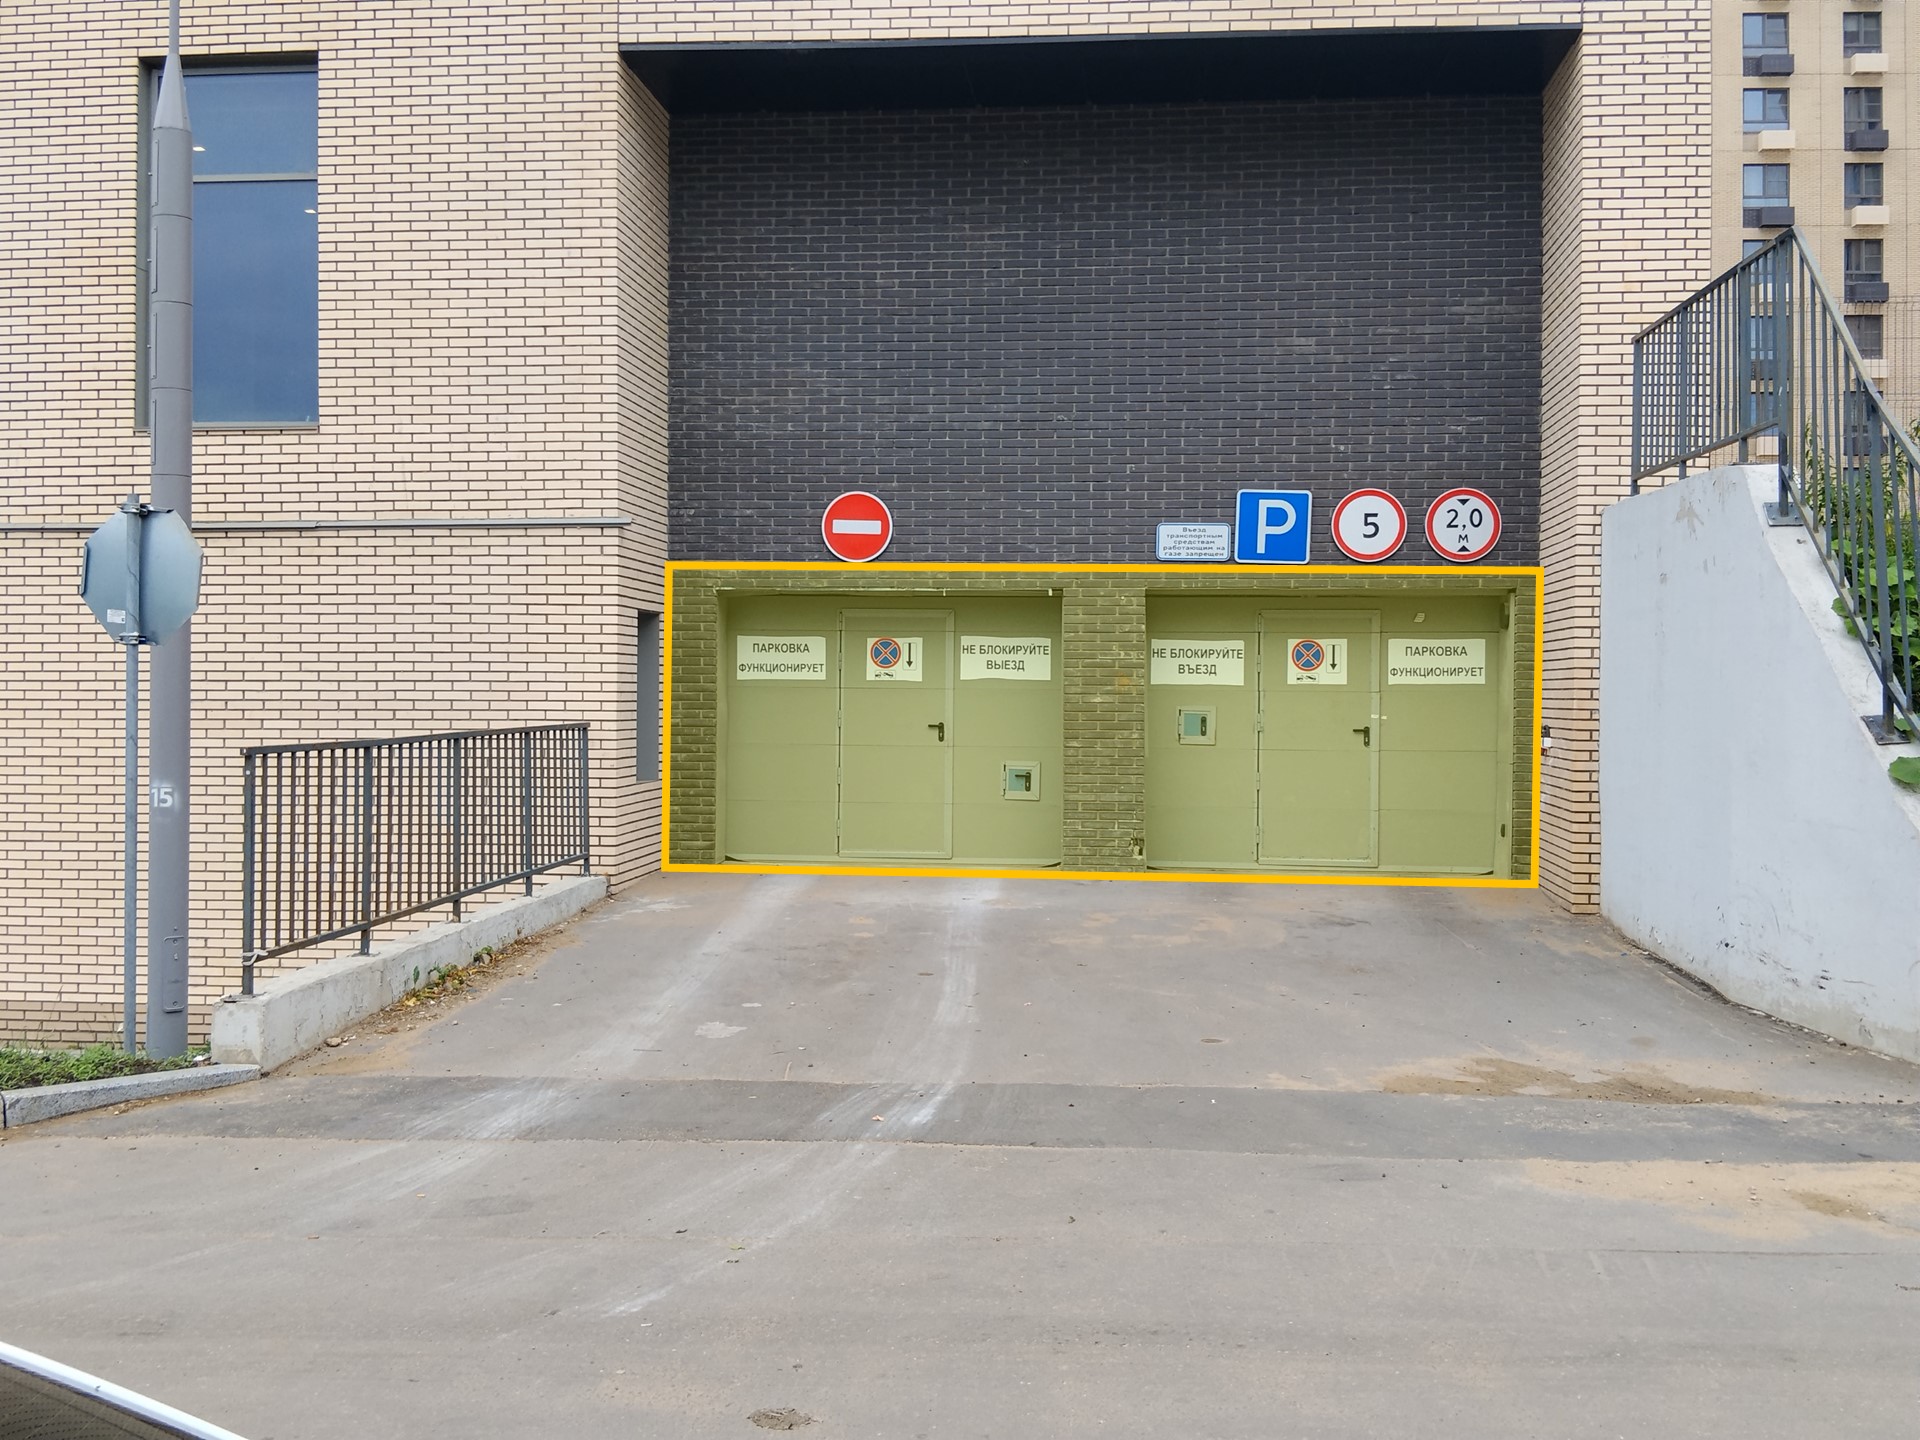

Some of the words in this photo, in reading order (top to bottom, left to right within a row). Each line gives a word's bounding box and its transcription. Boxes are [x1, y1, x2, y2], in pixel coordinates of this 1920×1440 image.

[1362, 512, 1380, 538] 5
[1446, 508, 1483, 531] 2,0
[1256, 499, 1297, 554] P
[752, 643, 810, 653] ПАРКОВКА
[962, 644, 976, 654] НЕ
[979, 643, 1049, 656] БЛОКИРУЙТЕ
[1152, 648, 1167, 658] НЕ
[1170, 647, 1243, 659] БЛОКИРУЙТЕ
[1405, 646, 1468, 656] ПАРКОВКА
[738, 663, 824, 674] ФУНКЦИОНИРУЕТ
[986, 660, 1025, 672] ВЫЕЗД
[1178, 664, 1217, 676] ВЪЕЗД
[1390, 667, 1484, 678] ФУНКЦИОНИРУЕТ
[151, 788, 173, 808] 15
